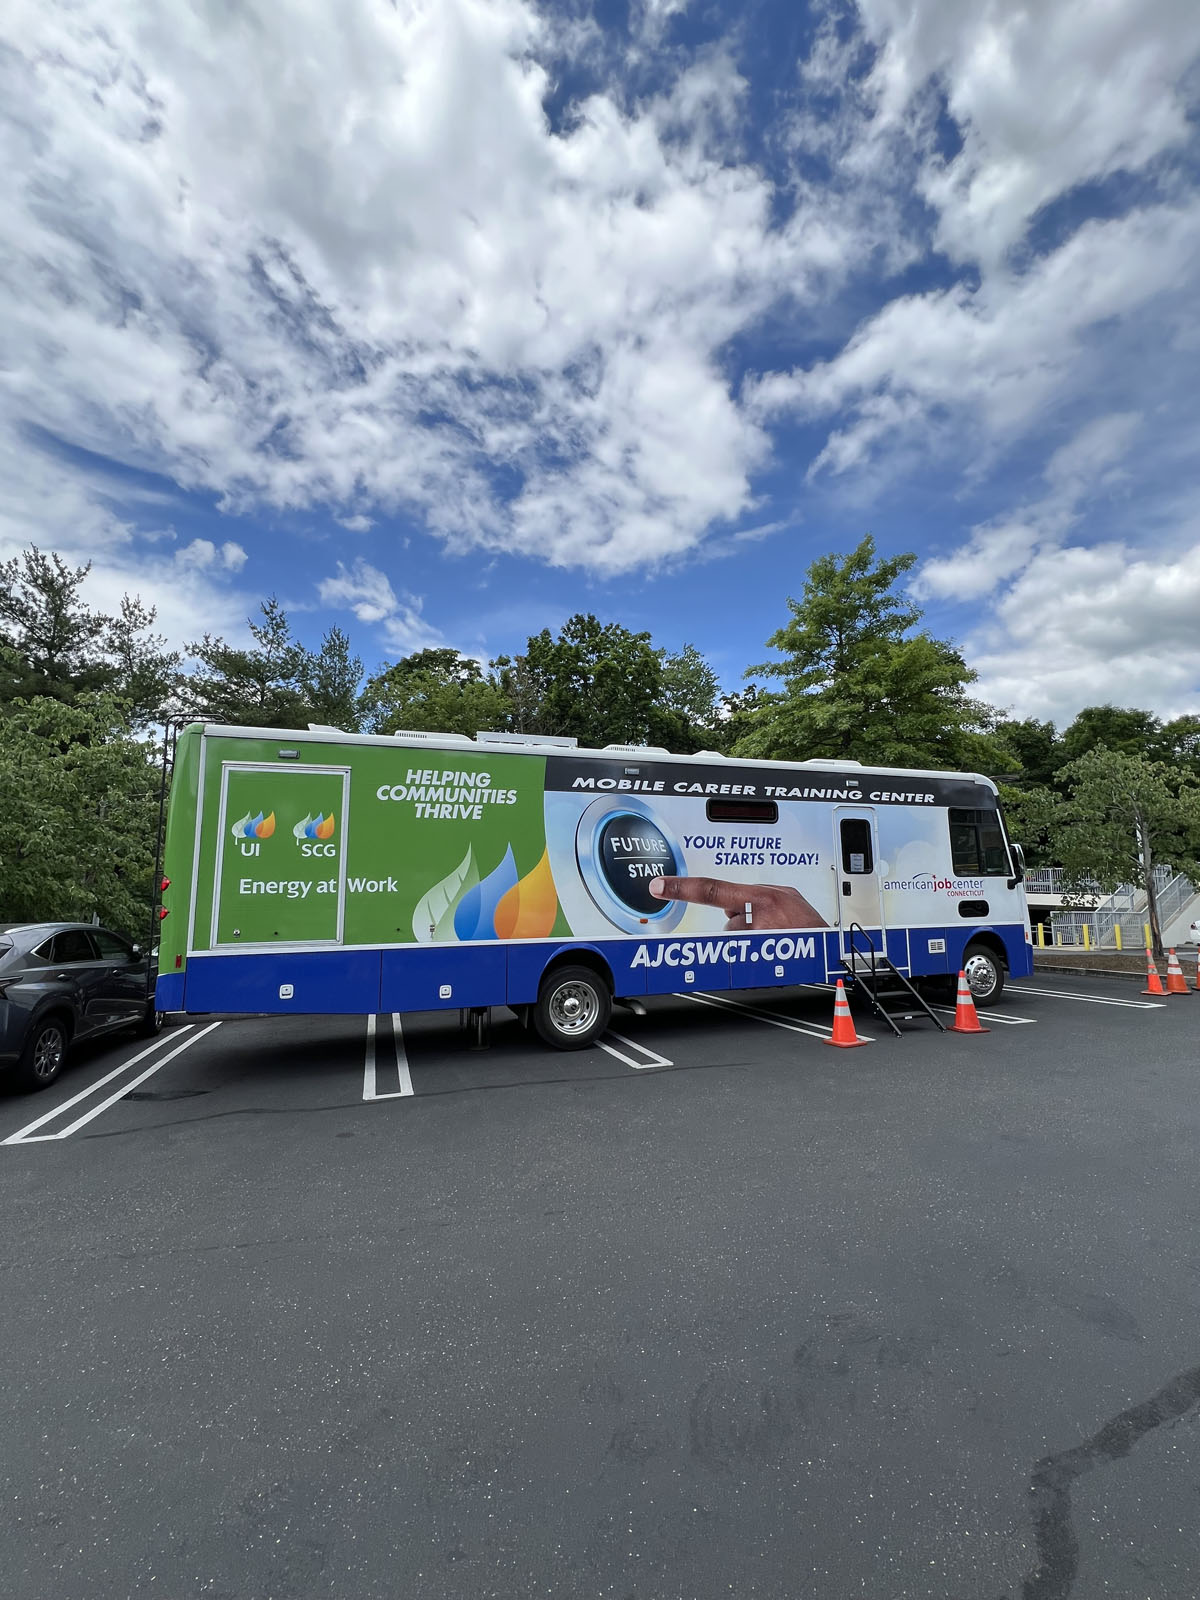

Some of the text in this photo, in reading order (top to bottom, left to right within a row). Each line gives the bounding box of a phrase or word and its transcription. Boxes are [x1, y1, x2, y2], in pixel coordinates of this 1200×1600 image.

[405, 769, 491, 787] HELPING
[376, 785, 518, 804] COMMUNITIES
[571, 777, 935, 804] MOBILE CAREER TRAINING CENTER
[414, 803, 483, 820] THRIVE
[240, 843, 260, 857] UI
[300, 843, 336, 857] SCG
[610, 837, 667, 852] FUTURE
[683, 835, 782, 849] YOUR FUTURE
[714, 853, 820, 865] STARTS TODAY!
[628, 863, 665, 878] START
[239, 876, 399, 898] Energy at Work
[630, 937, 816, 968] AJCSWCT.COM
